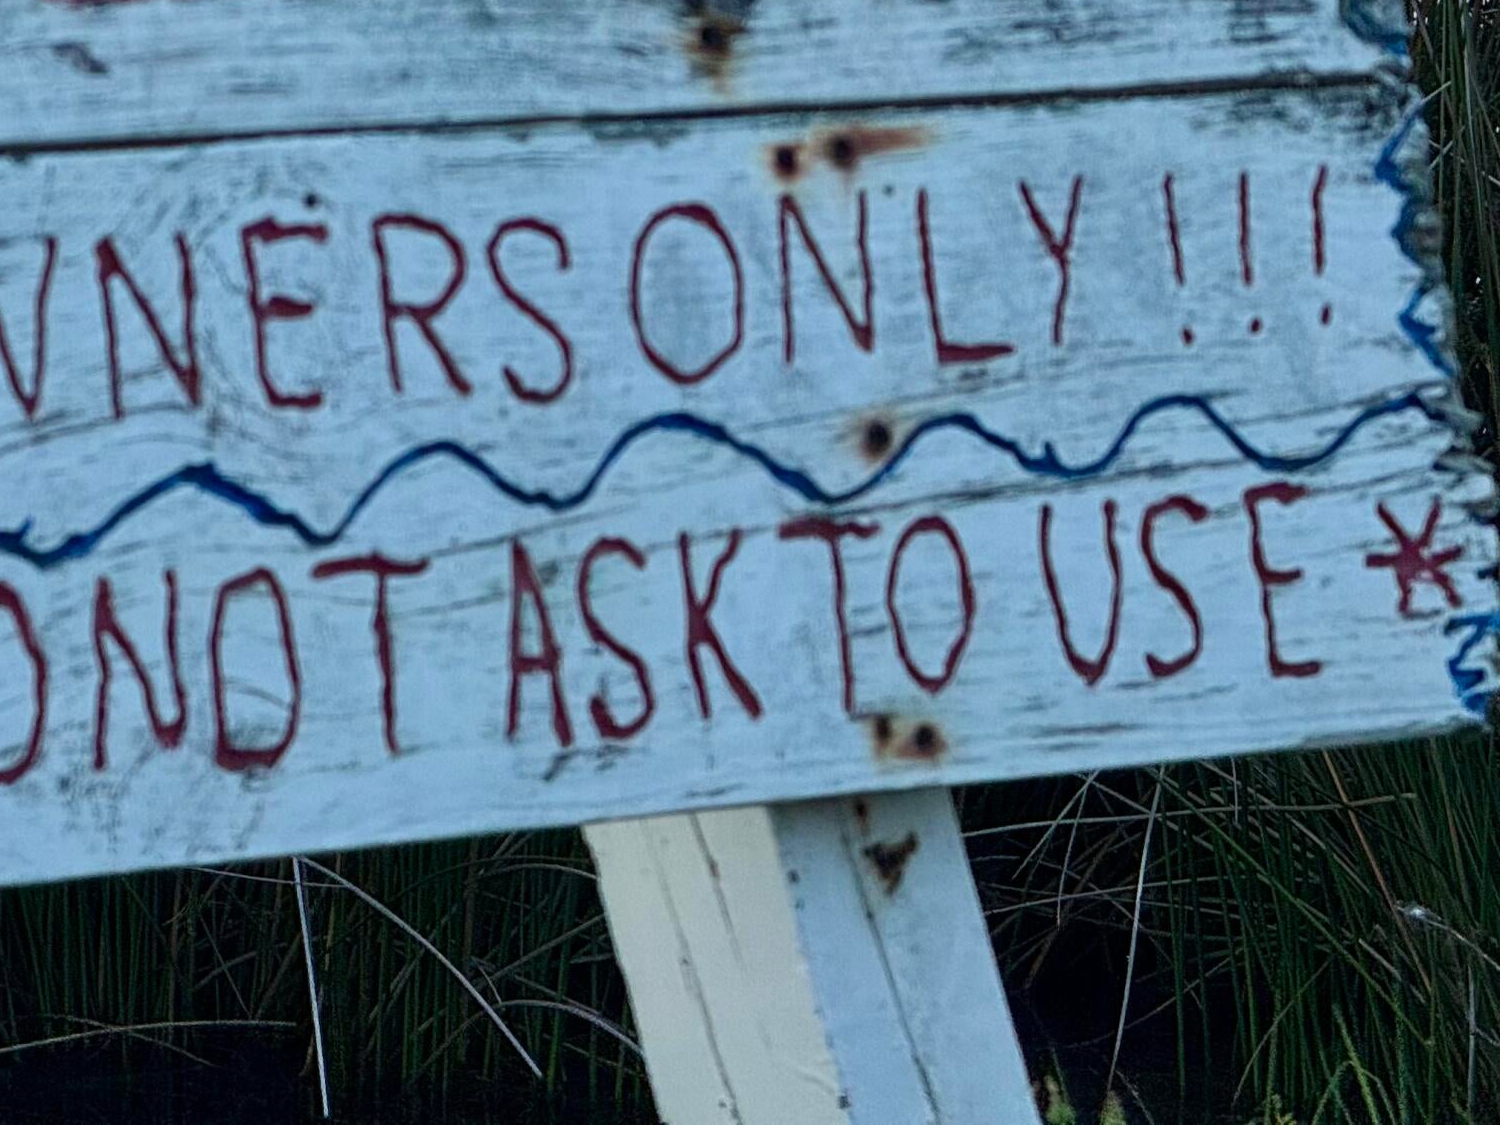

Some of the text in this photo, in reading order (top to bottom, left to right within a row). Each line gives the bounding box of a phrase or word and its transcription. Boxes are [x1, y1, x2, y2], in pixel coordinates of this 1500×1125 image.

[94, 553, 426, 772] NOT
[508, 525, 762, 751] ASK
[780, 511, 974, 715] TO
[1040, 483, 1323, 687] USE
